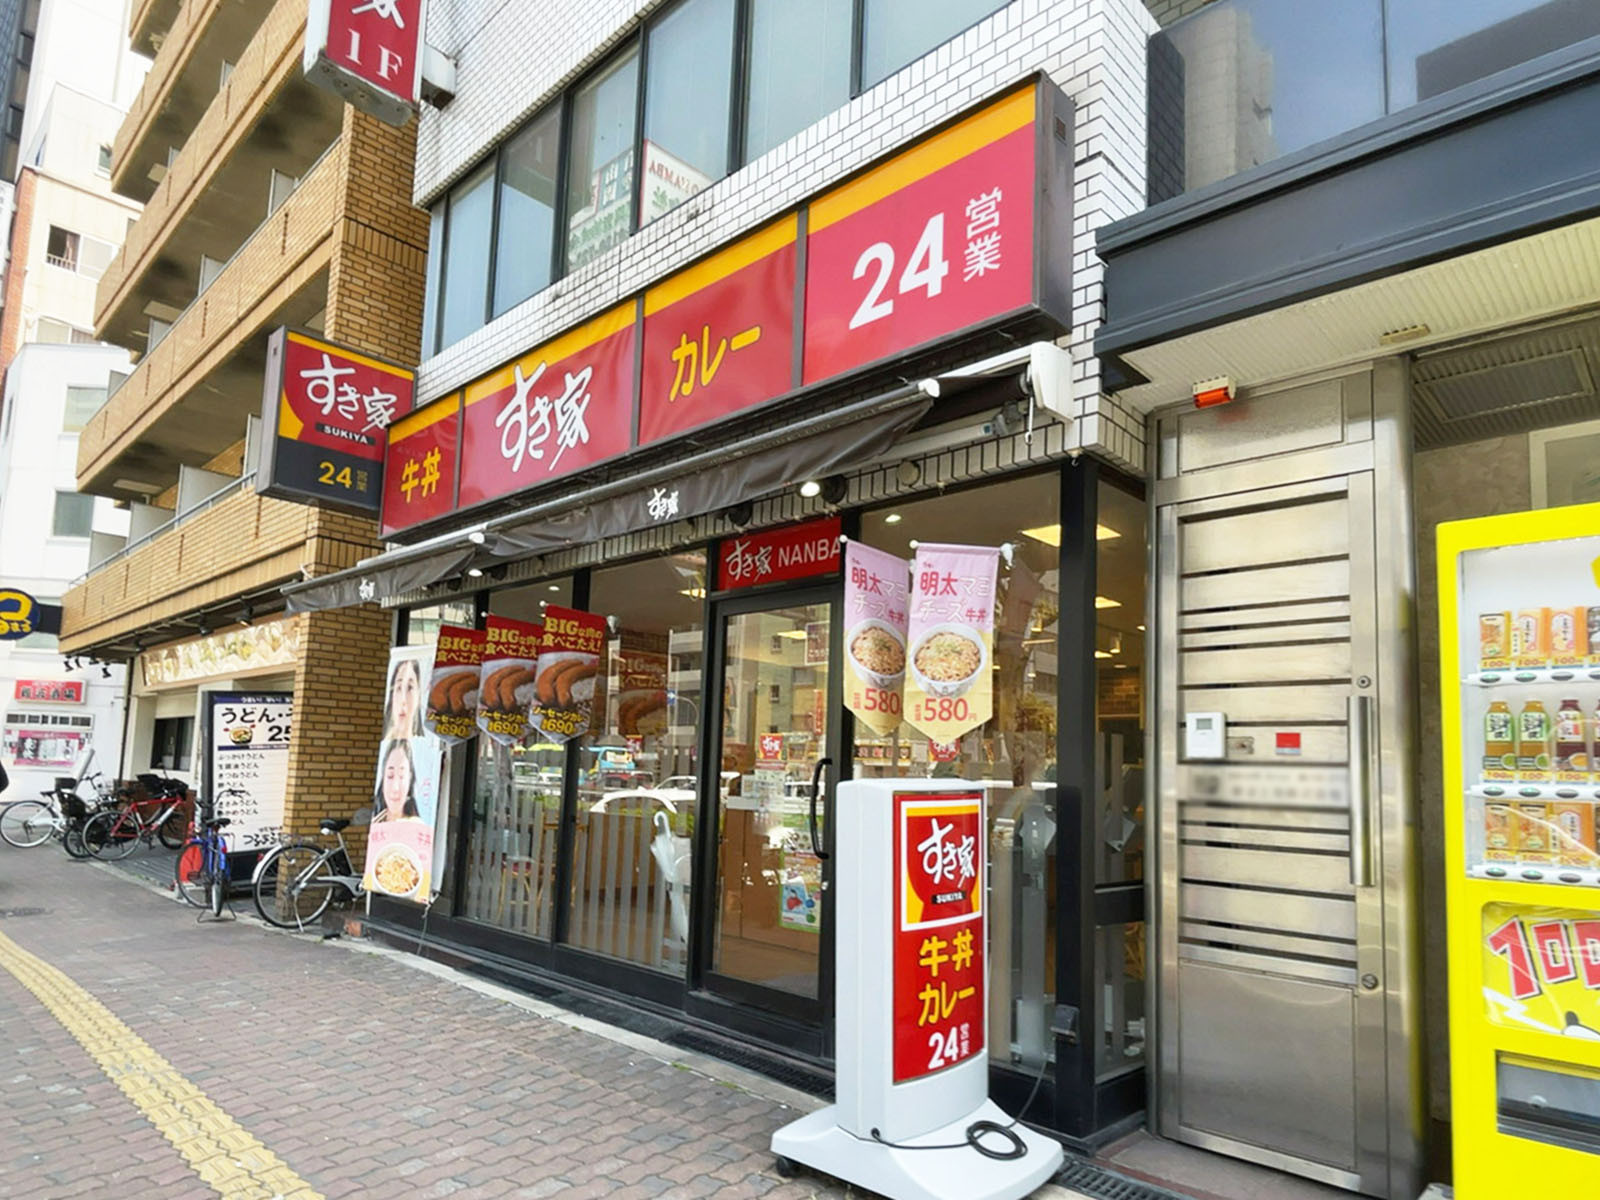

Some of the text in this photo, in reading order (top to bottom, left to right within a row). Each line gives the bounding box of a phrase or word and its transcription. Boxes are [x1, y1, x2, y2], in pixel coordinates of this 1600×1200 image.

[848, 187, 1002, 330] 24 営業
[669, 325, 761, 402] カレー
[299, 353, 397, 433] すき家
[495, 360, 593, 472] すき家
[323, 424, 369, 445] SUKIYA
[318, 461, 352, 489] 24
[401, 447, 441, 503] 牛丼
[647, 487, 679, 520] すき家
[726, 537, 841, 582] すき家 NANBA
[864, 687, 900, 716] 580
[917, 818, 975, 888] すき家
[919, 929, 974, 977] 牛丼
[918, 981, 976, 1027] カレー
[927, 1026, 959, 1070] 24
